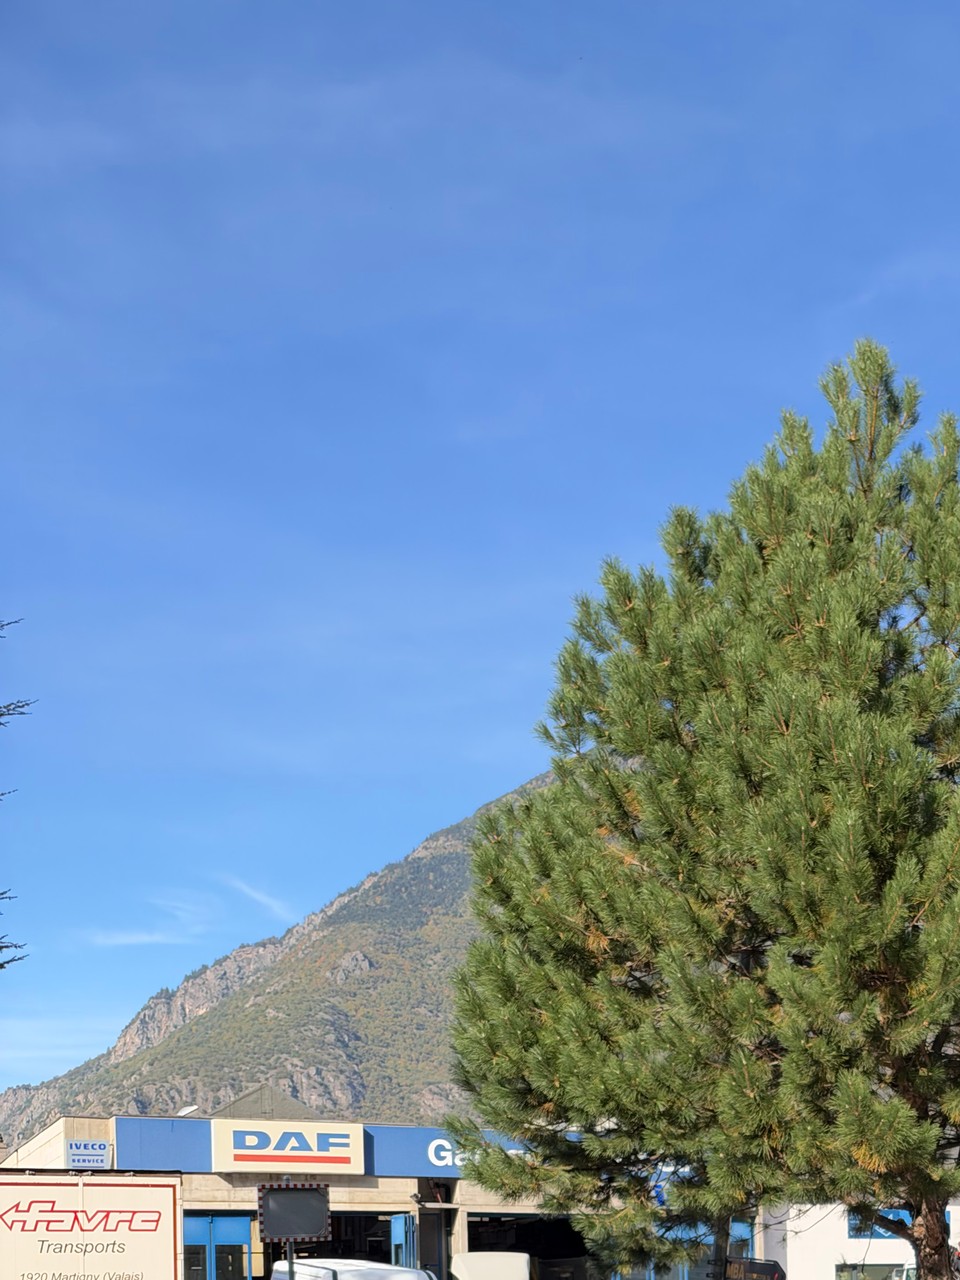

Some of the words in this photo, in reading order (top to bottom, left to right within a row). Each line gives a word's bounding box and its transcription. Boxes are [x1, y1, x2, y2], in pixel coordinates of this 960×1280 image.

[69, 1142, 107, 1151] IVECO
[232, 1130, 351, 1152] DAF
[37, 1239, 126, 1256] Transports
